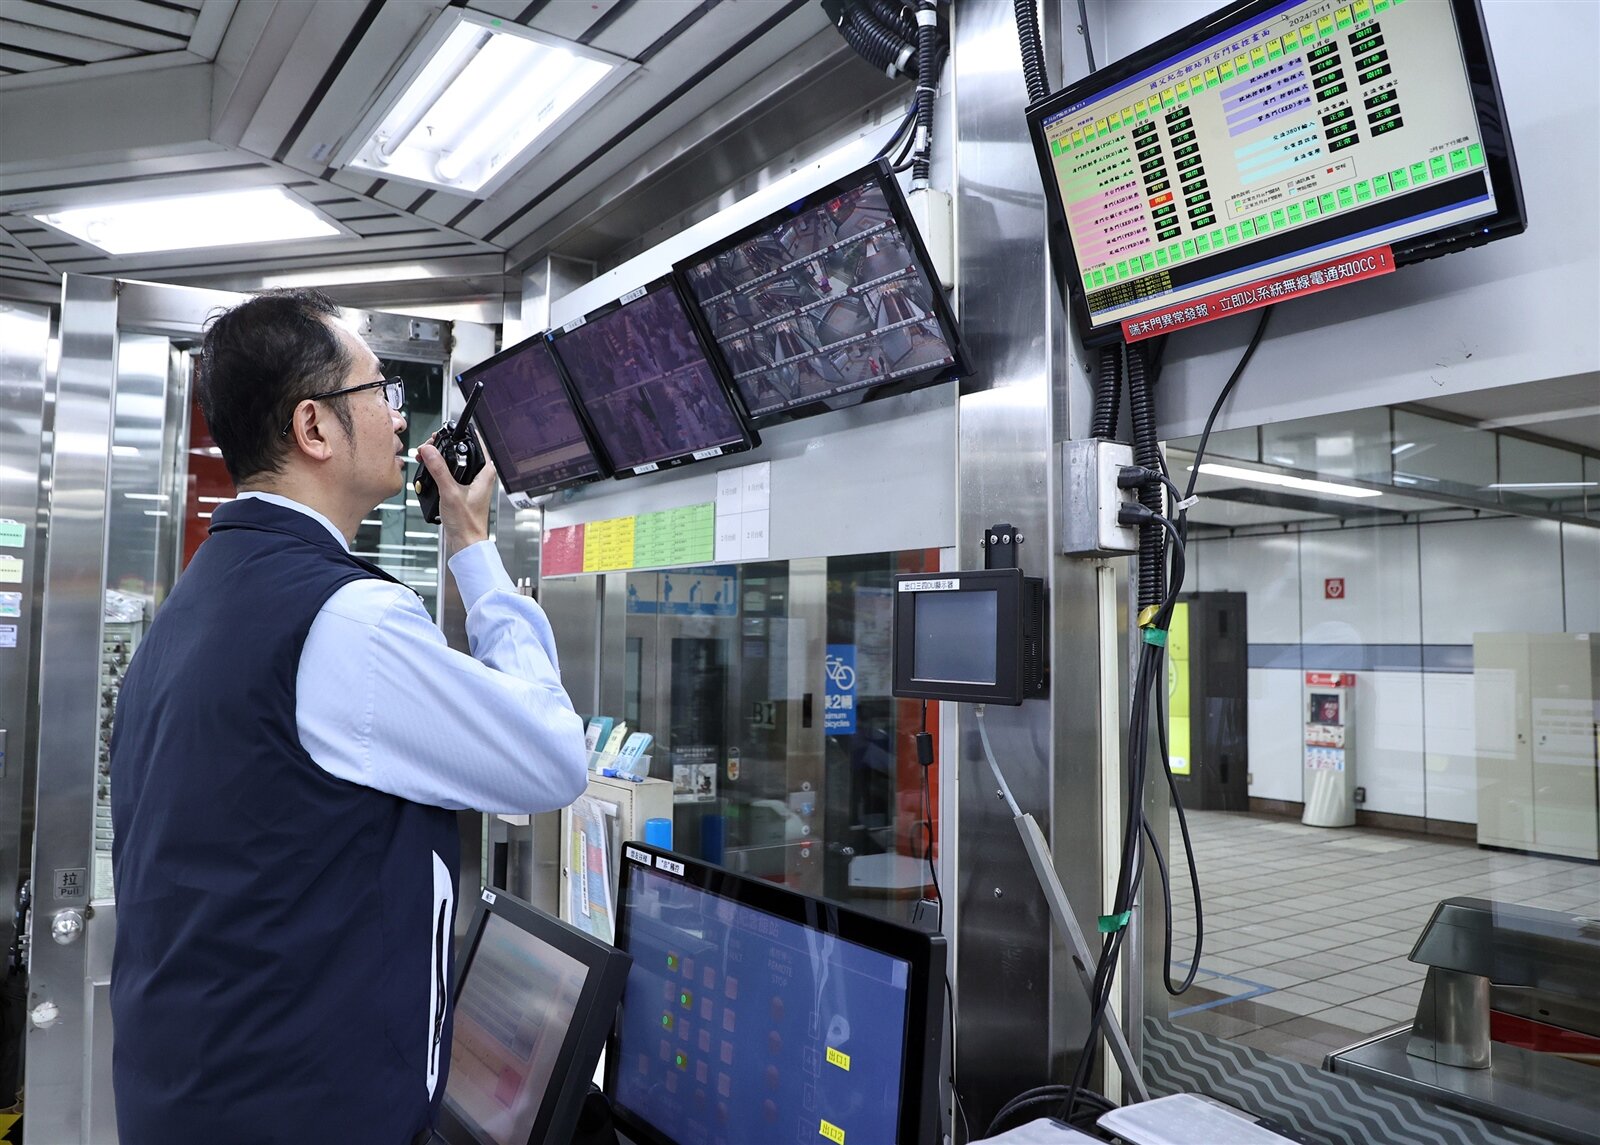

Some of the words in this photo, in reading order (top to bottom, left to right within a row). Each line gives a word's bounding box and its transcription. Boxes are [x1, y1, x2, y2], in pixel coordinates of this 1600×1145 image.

[1288, 2, 1330, 27] 2024/3/11
[1128, 254, 1387, 337] 端末門異常發報，立即以系統無線電通知OCC！
[63, 872, 78, 886] 拉
[60, 888, 79, 896] Pull
[828, 1049, 848, 1067] 出口1
[822, 1123, 843, 1142] 出口2
